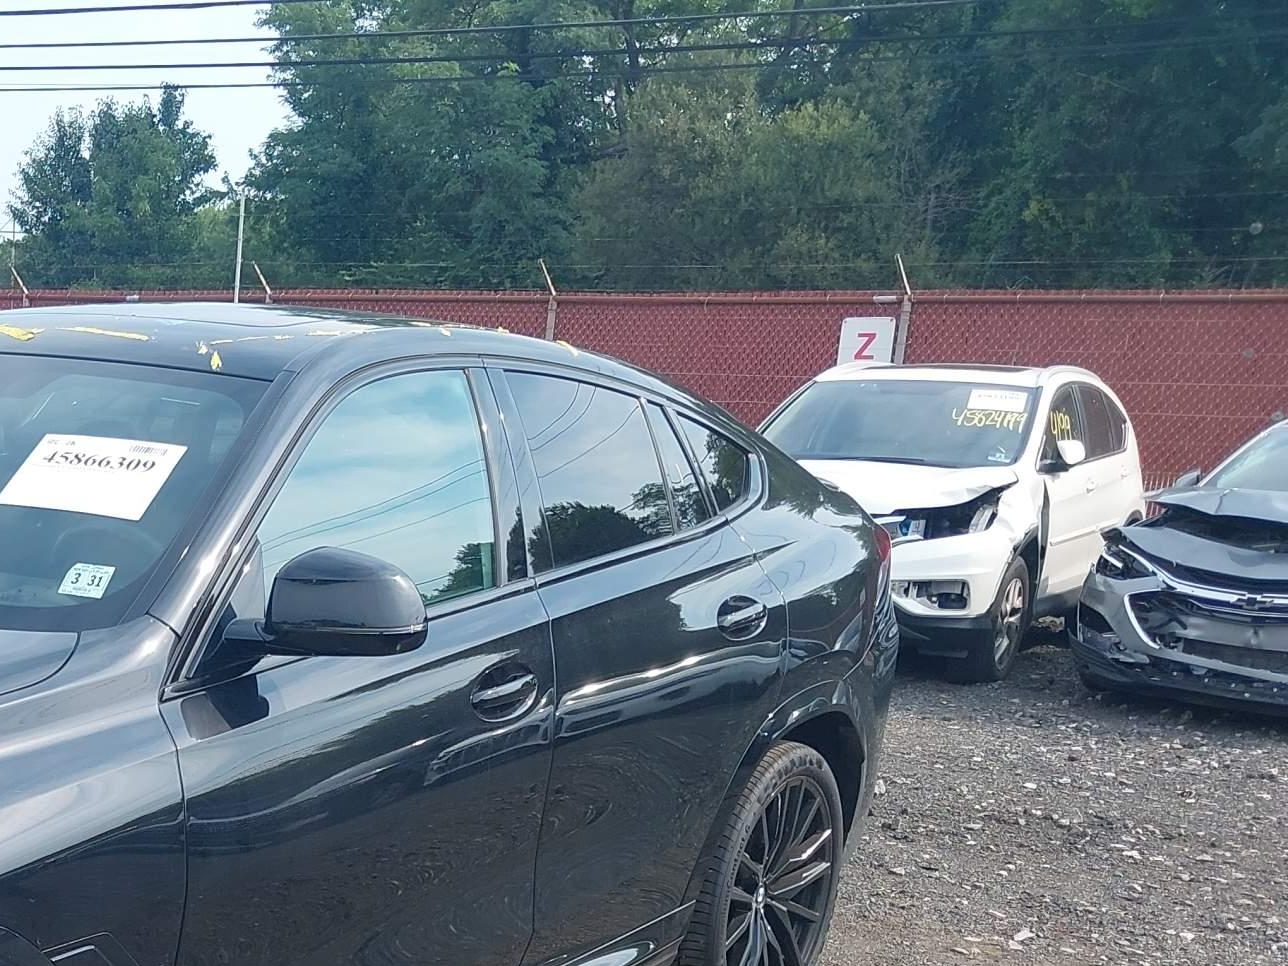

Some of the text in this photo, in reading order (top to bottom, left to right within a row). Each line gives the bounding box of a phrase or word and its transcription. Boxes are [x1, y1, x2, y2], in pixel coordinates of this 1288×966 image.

[854, 332, 877, 360] Z
[43, 451, 156, 472] 45866309
[70, 572, 103, 587] 3 31
